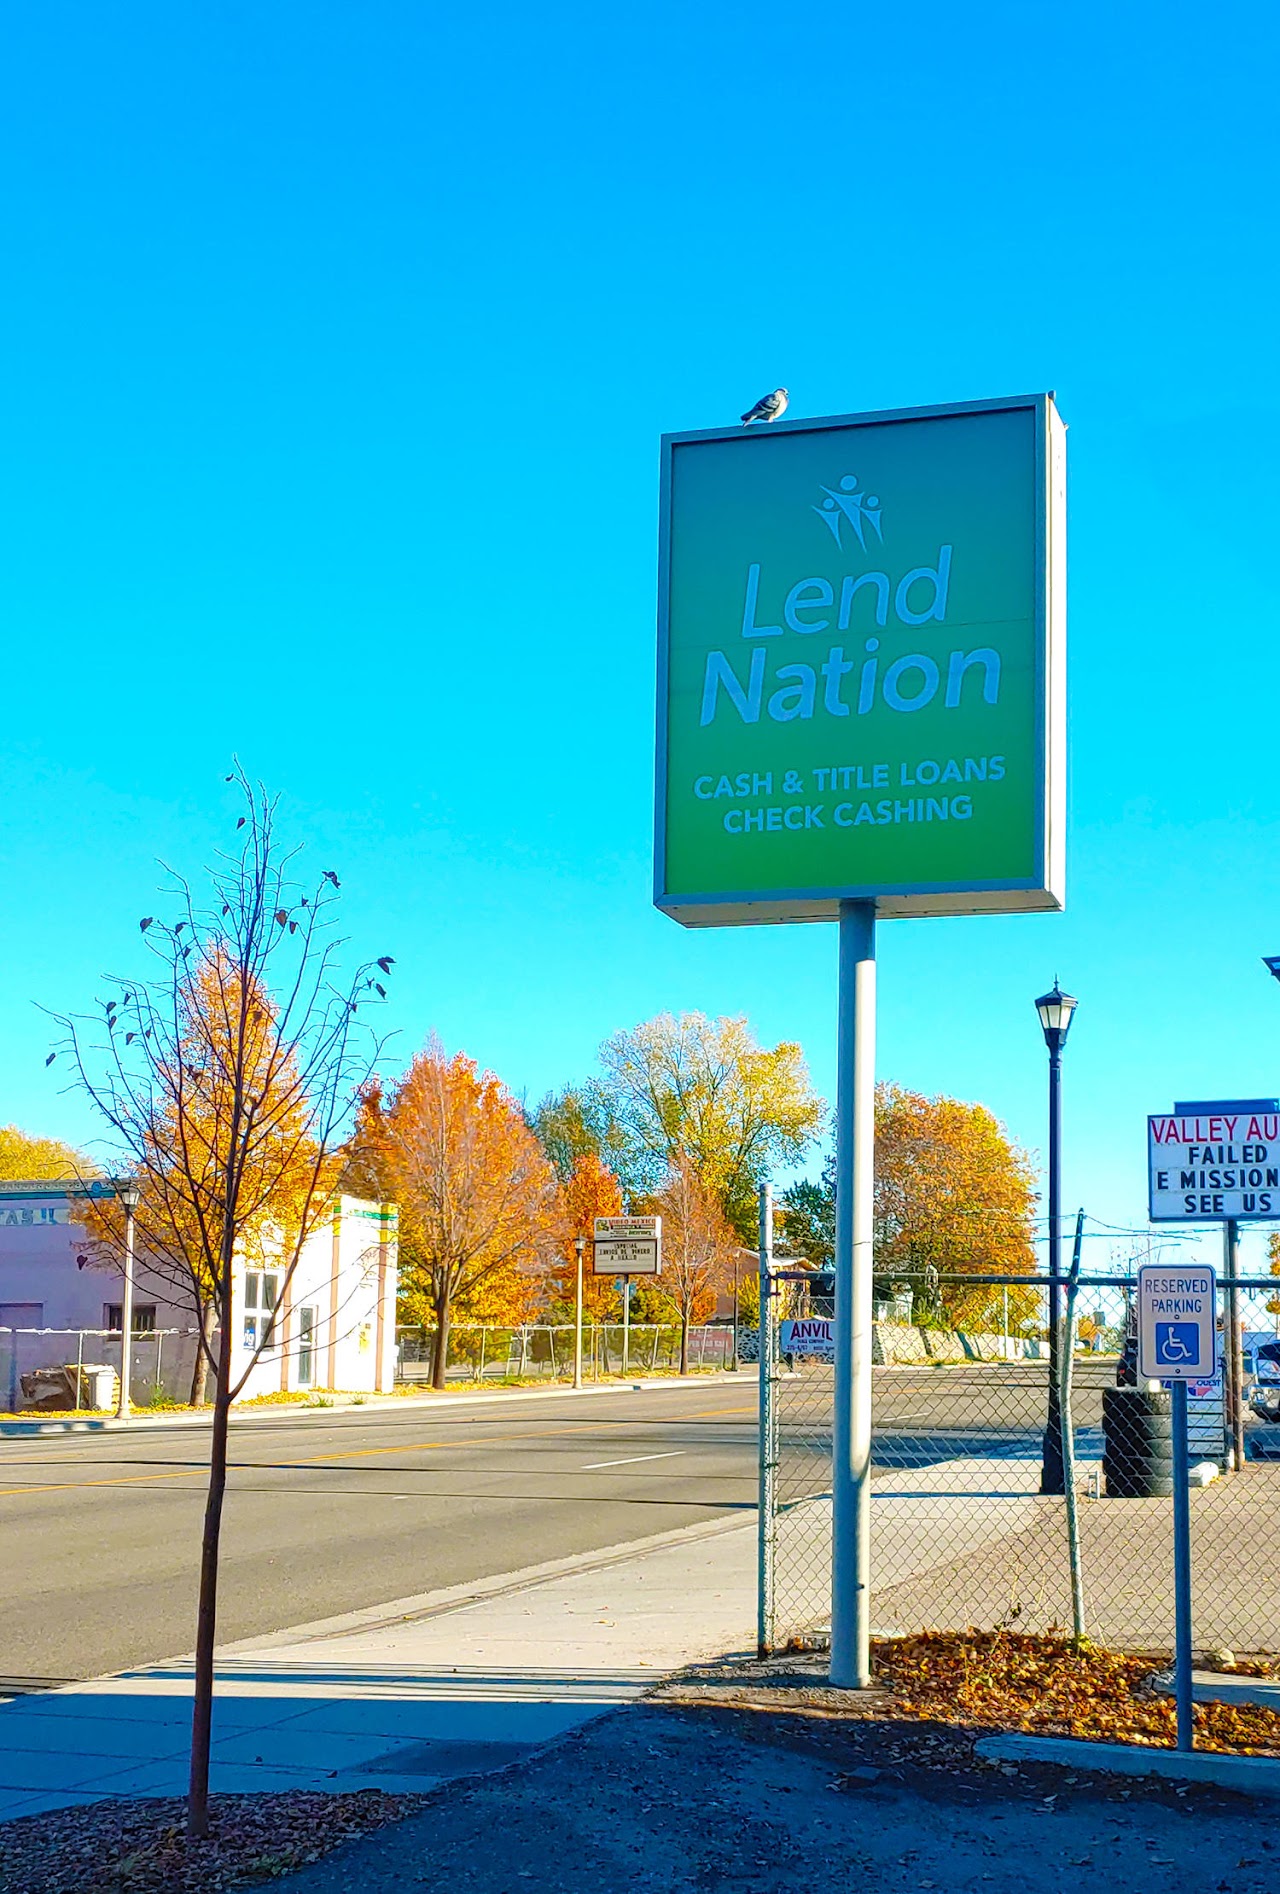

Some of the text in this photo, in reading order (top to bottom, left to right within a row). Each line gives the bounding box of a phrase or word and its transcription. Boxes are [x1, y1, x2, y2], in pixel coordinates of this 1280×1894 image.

[741, 544, 953, 639] Lend
[700, 637, 1001, 727] Nation
[693, 755, 1006, 800] CASH & TITLE LOANS
[723, 795, 974, 834] CHECK CASHING
[1151, 1115, 1280, 1144] VALLEY AU
[1188, 1144, 1268, 1165] FAILED
[1184, 1193, 1272, 1213] SEE US
[1145, 1278, 1208, 1293] RESERVED
[1151, 1298, 1202, 1313] PARKING
[790, 1321, 834, 1341] ANVIL
